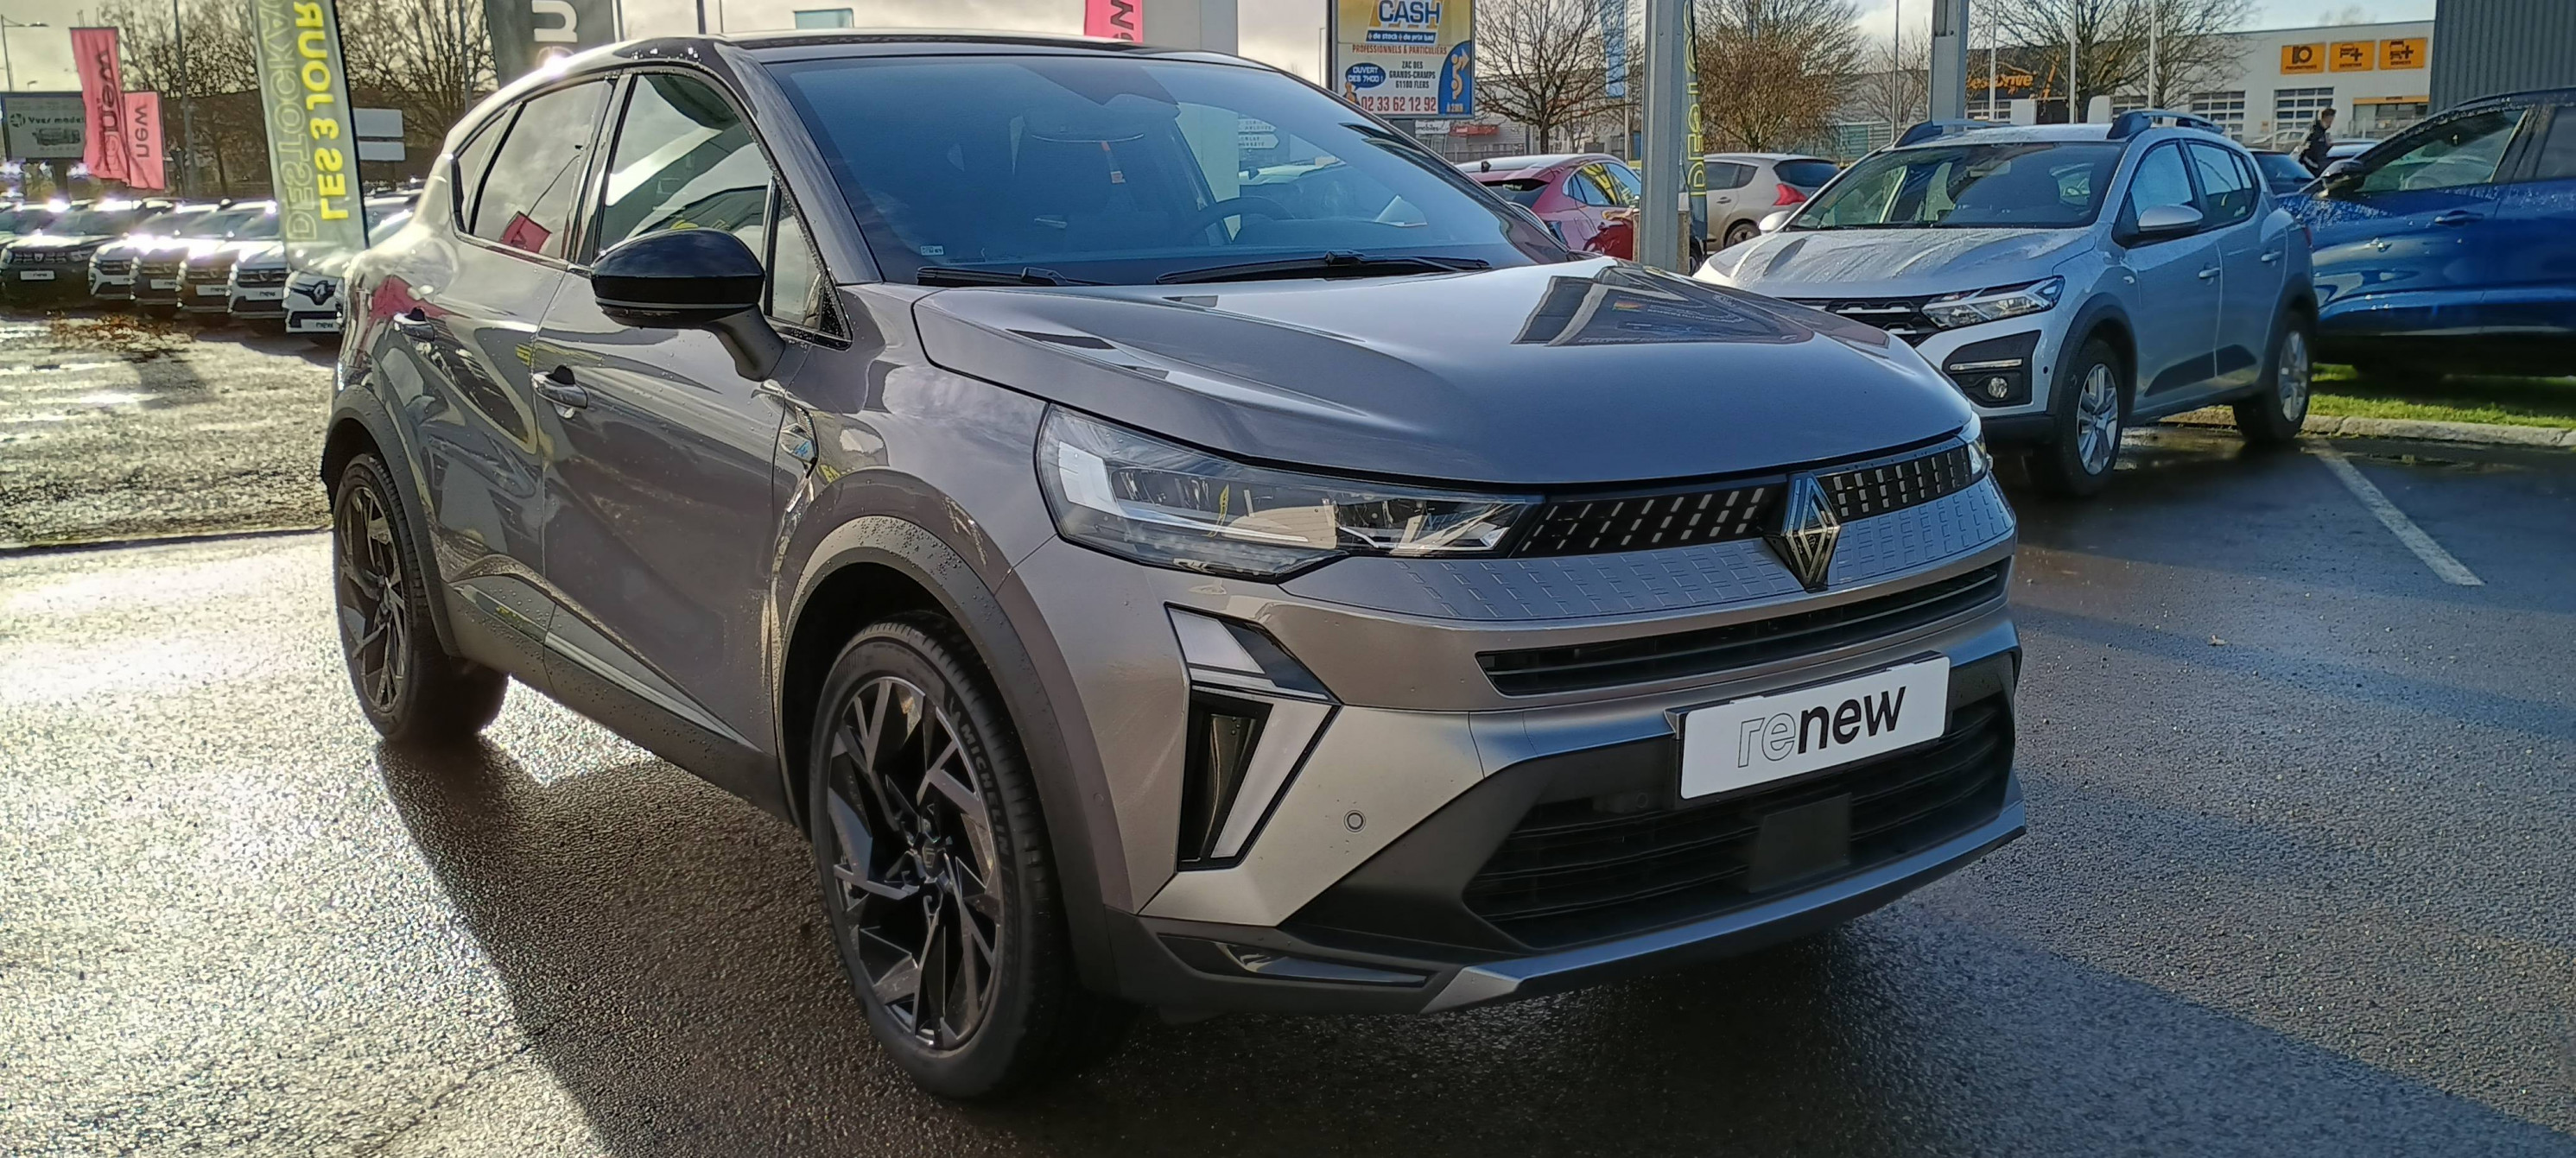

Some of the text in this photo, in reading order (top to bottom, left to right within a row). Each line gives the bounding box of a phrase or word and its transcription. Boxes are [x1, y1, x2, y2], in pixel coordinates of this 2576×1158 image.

[1379, 1, 1441, 23] CASH
[1352, 44, 1401, 54] PROFESSIONNELS
[1389, 70, 1436, 79] GRANDS-CHAMPS
[1361, 97, 1437, 111] 02 33 62 12 92
[1737, 686, 1907, 768] renew
[960, 724, 1010, 856] MICHELIN
